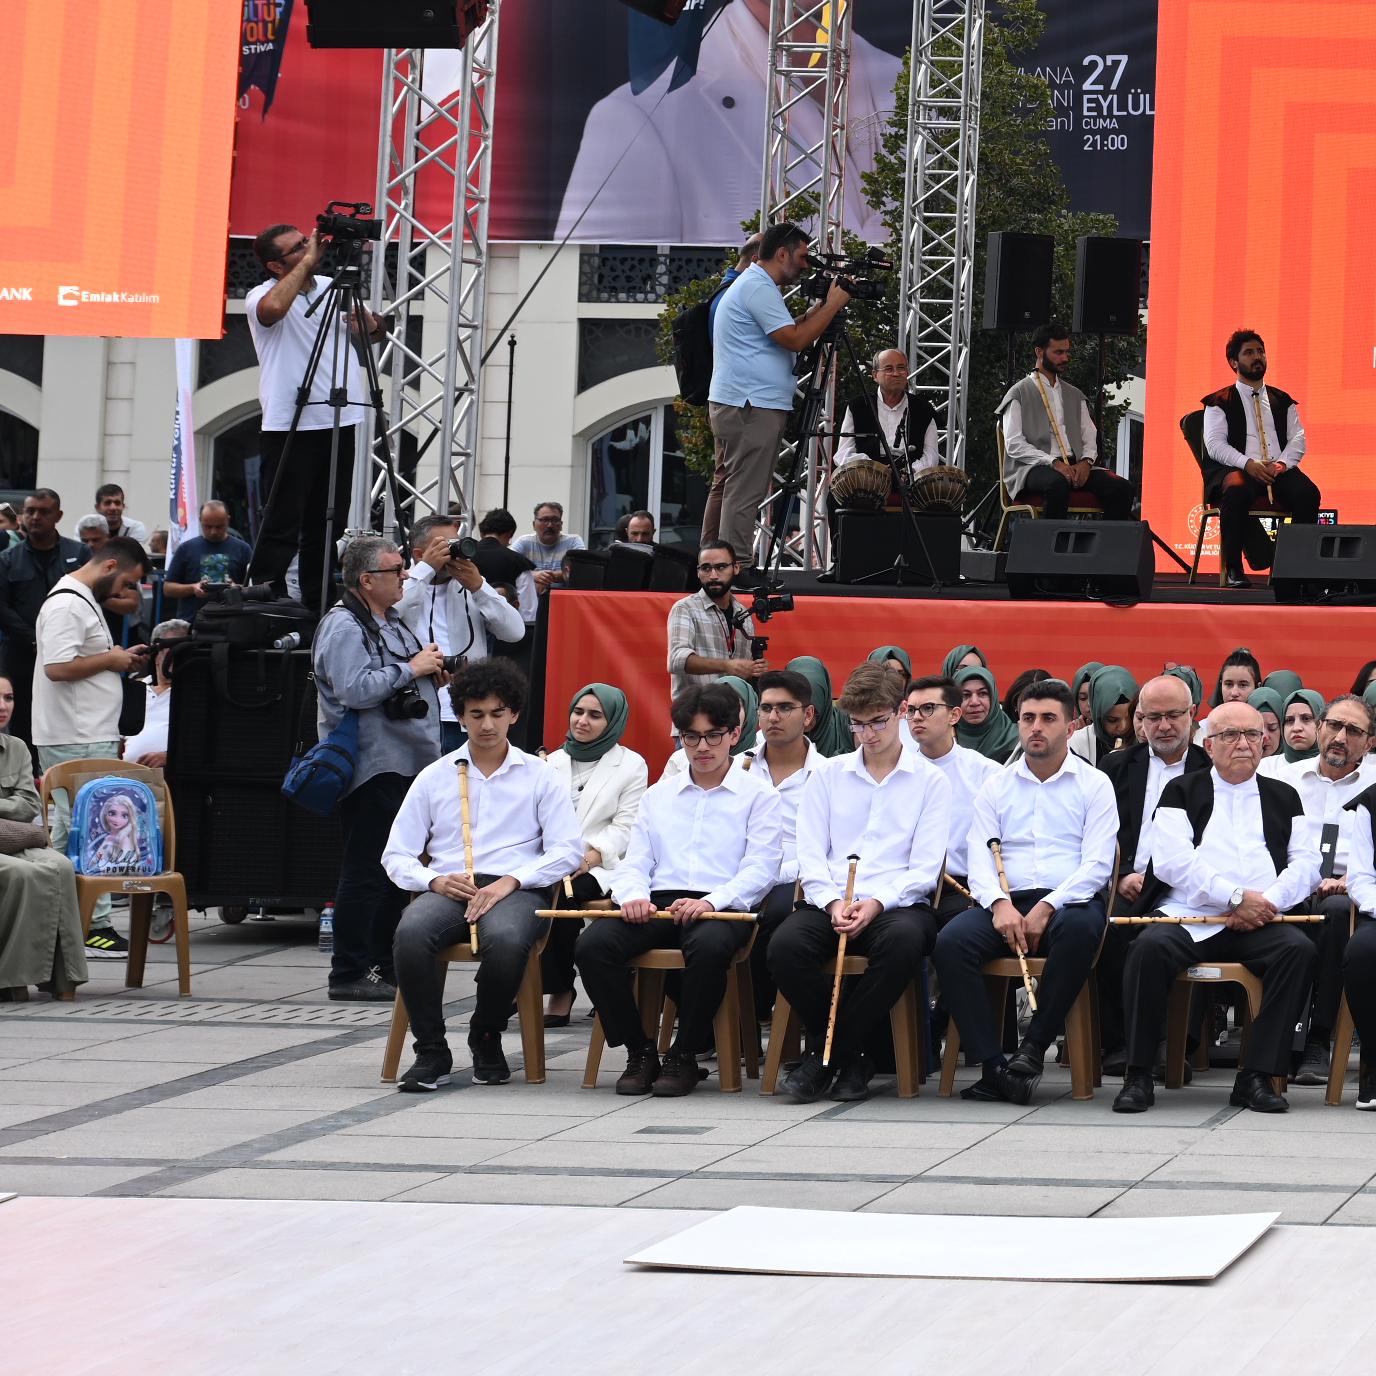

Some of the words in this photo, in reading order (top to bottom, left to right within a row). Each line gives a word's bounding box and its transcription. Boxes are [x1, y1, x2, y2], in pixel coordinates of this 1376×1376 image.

[1082, 54, 1129, 91] 27
[1082, 88, 1156, 116] EYLÜL
[1082, 118, 1119, 130] CUMA
[1083, 134, 1128, 151] 21:00
